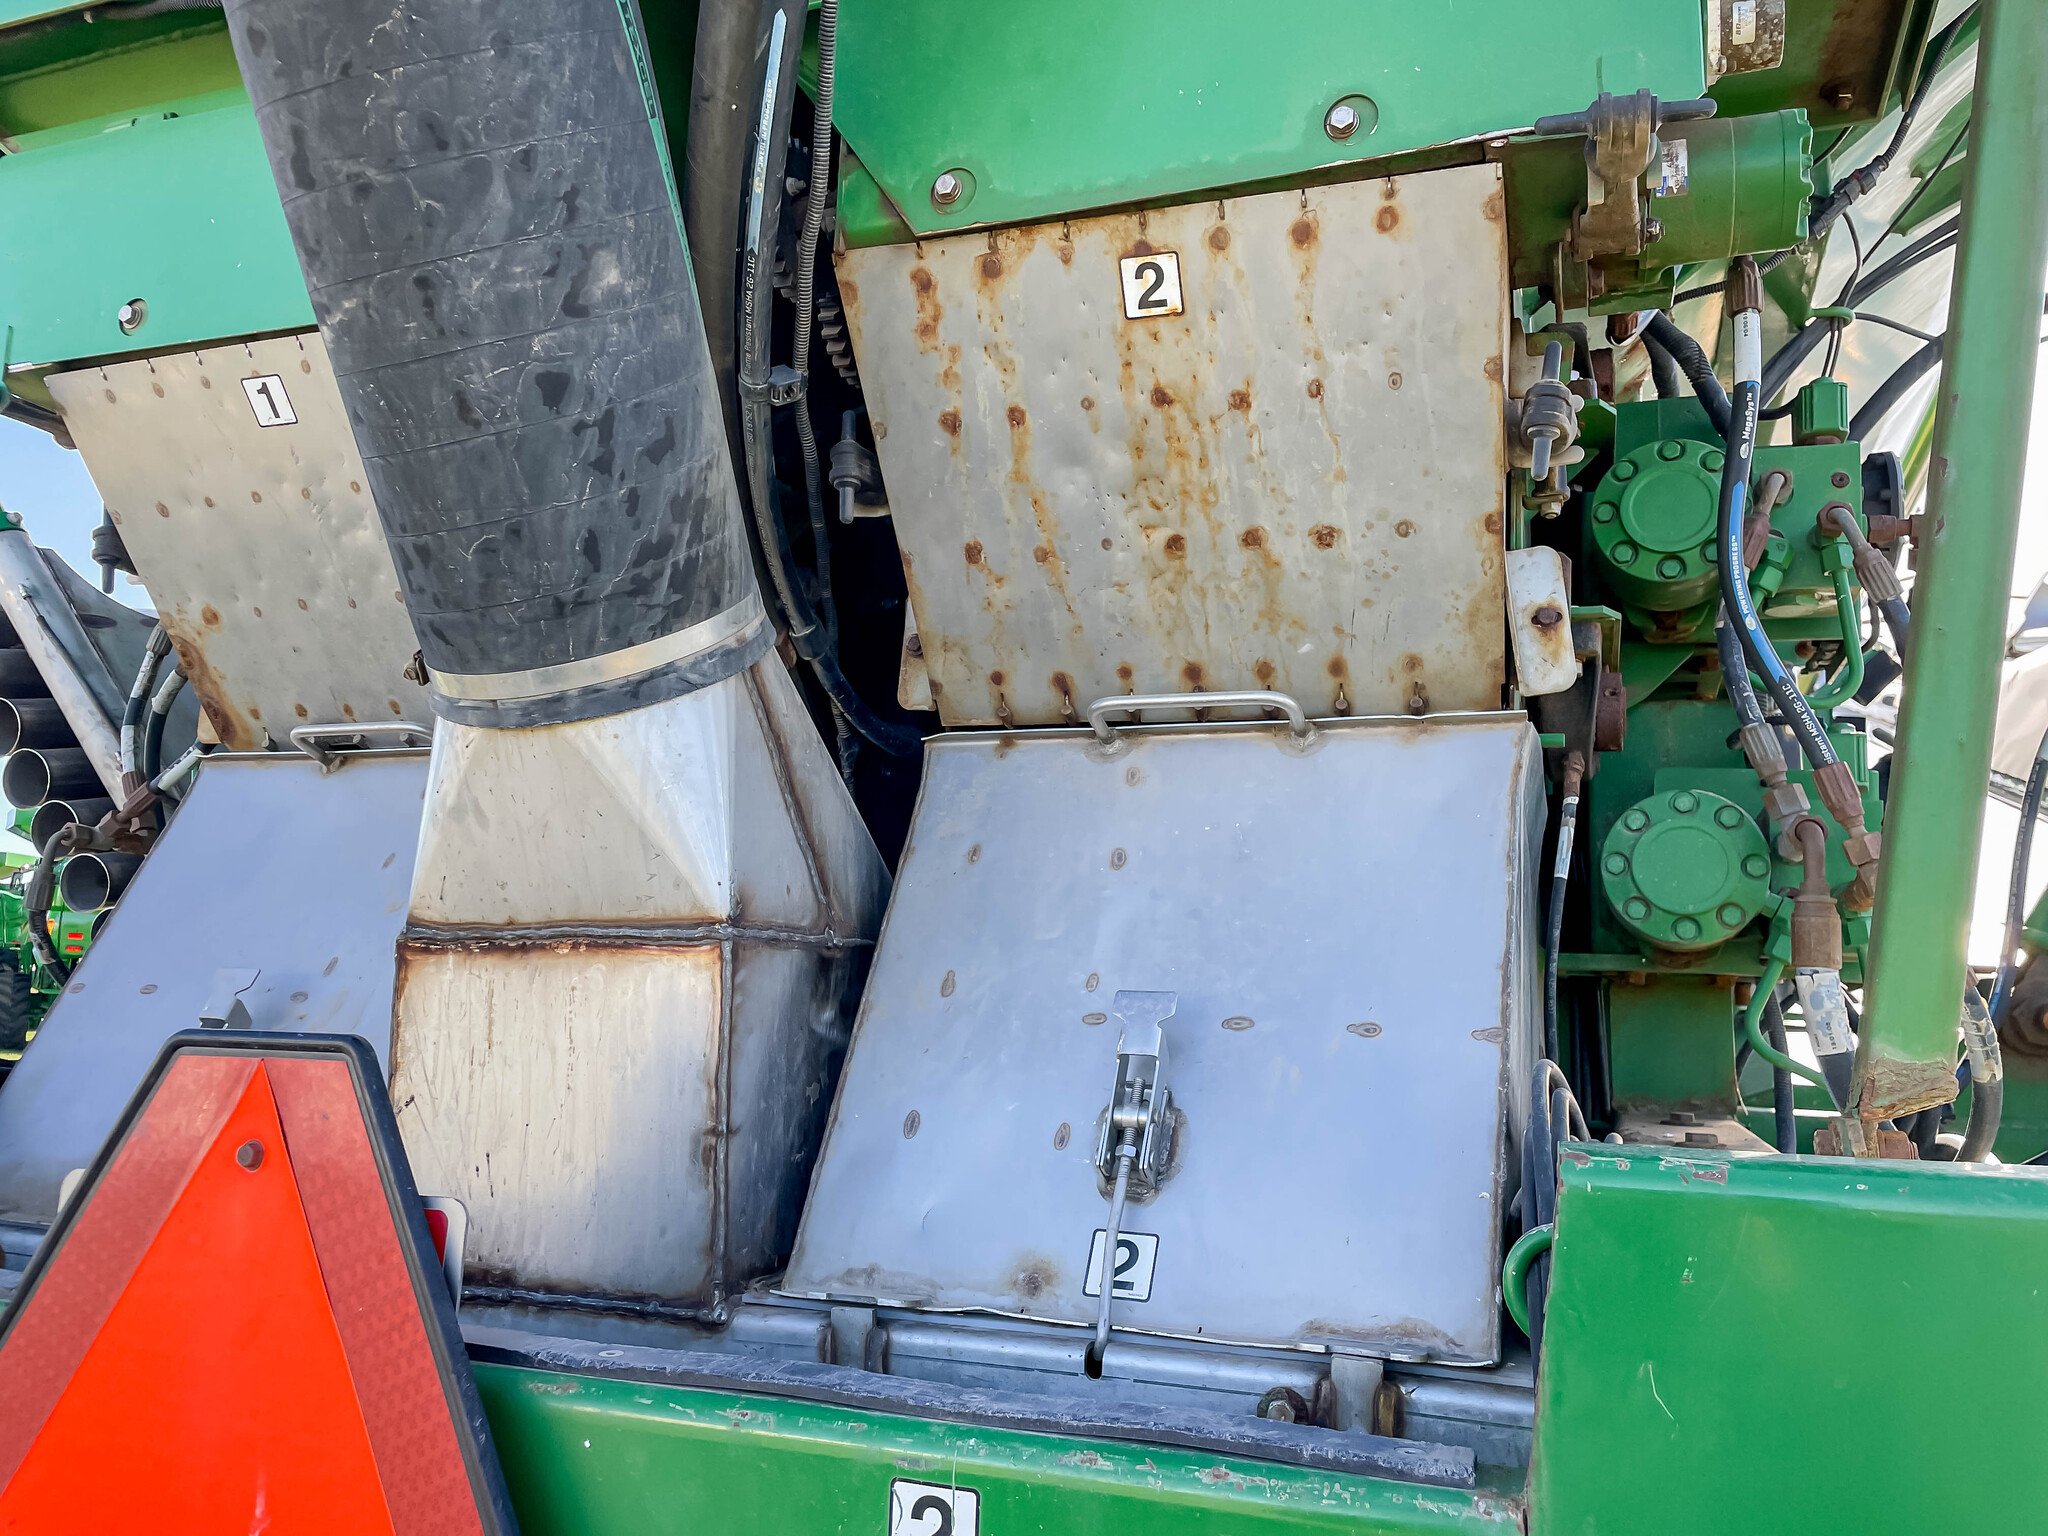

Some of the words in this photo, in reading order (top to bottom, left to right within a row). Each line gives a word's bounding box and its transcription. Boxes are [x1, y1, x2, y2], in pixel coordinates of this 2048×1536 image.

[746, 255, 755, 289] 2G-11C
[1135, 262, 1167, 309] 2
[745, 289, 753, 315] MSHA
[256, 382, 280, 418] 1
[1735, 579, 1750, 614] POWERING
[1782, 683, 1806, 713] 2G-11C
[1801, 712, 1818, 737] MSHA
[1101, 1239, 1139, 1291] 2
[911, 1495, 953, 1536] 2
